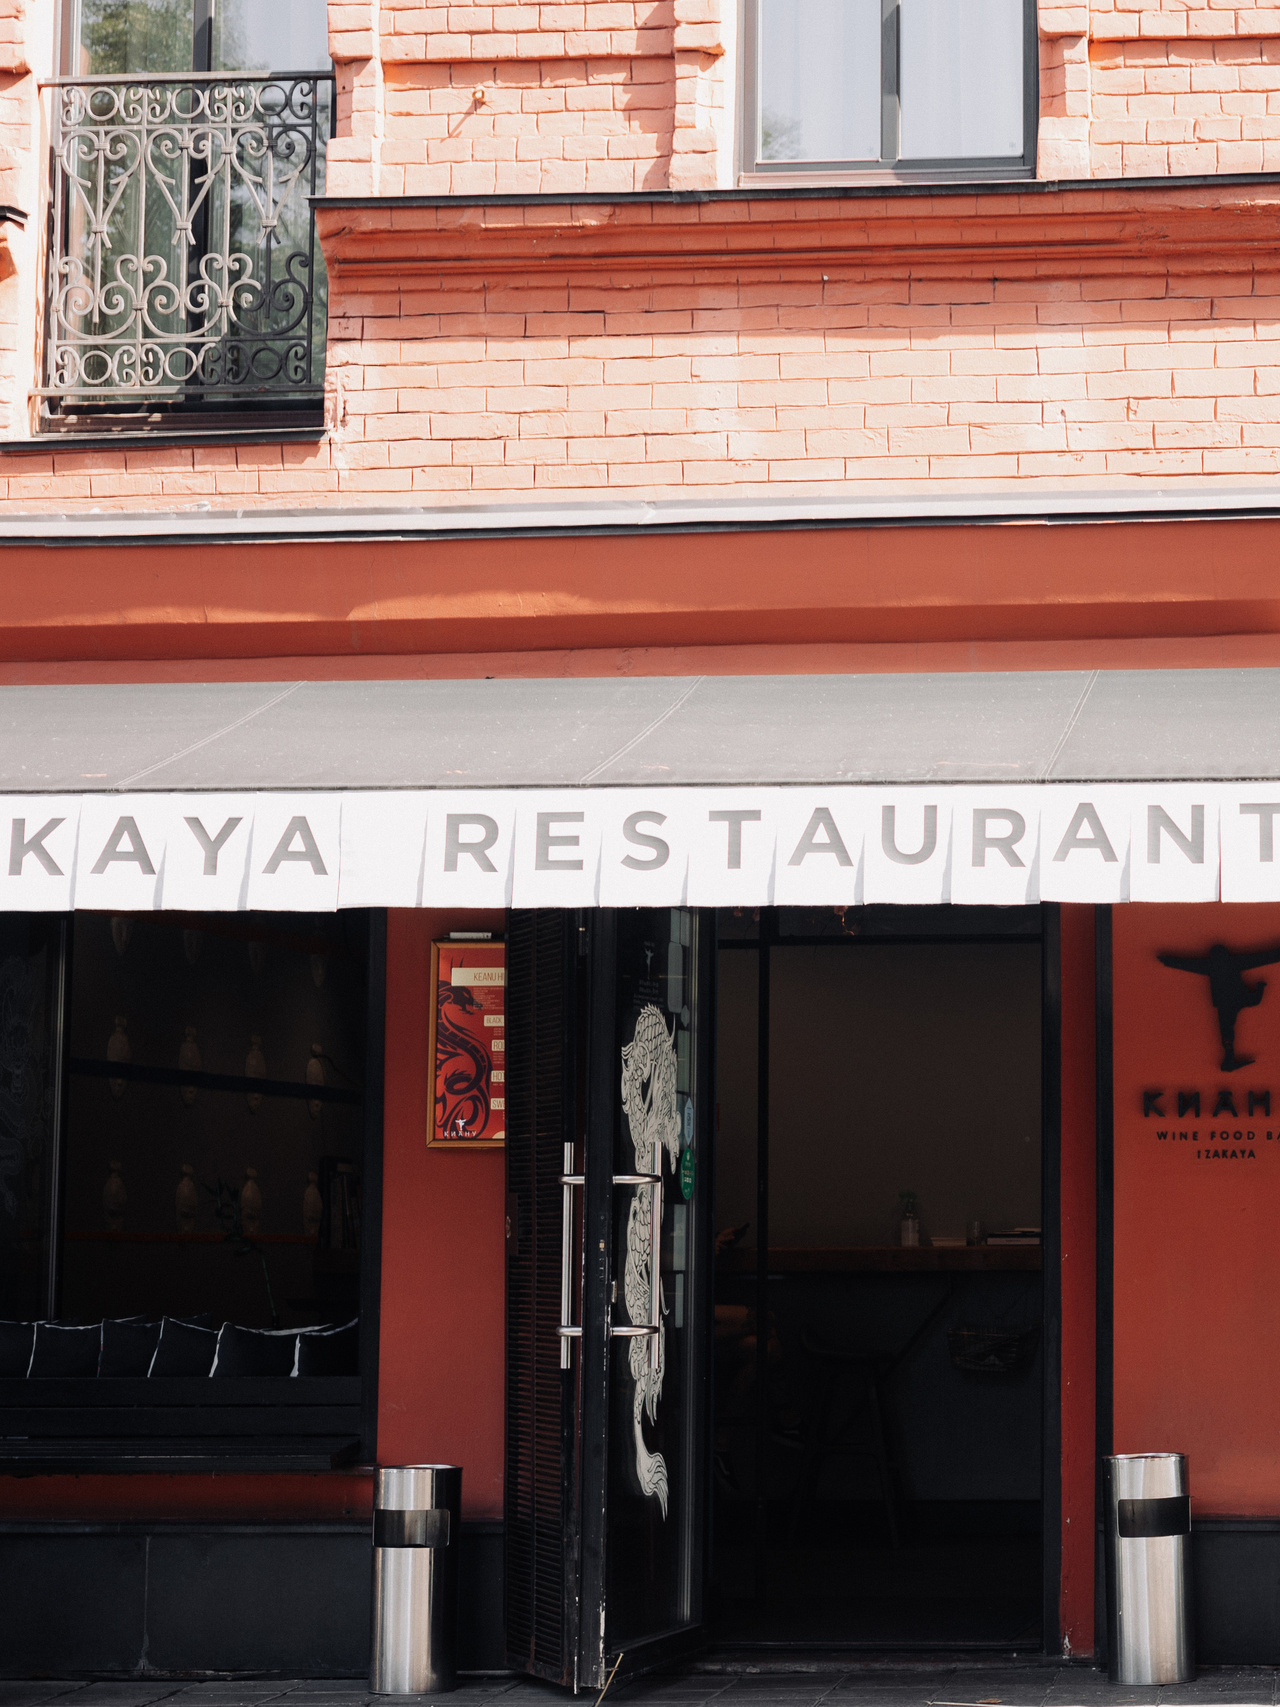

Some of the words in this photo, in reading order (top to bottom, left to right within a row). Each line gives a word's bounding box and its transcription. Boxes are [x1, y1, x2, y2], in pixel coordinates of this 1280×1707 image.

[473, 972, 497, 982] KEANU
[1156, 1131, 1199, 1141] WINE
[1210, 1131, 1256, 1141] FOOD
[1197, 1149, 1256, 1159] IZAKAYA
